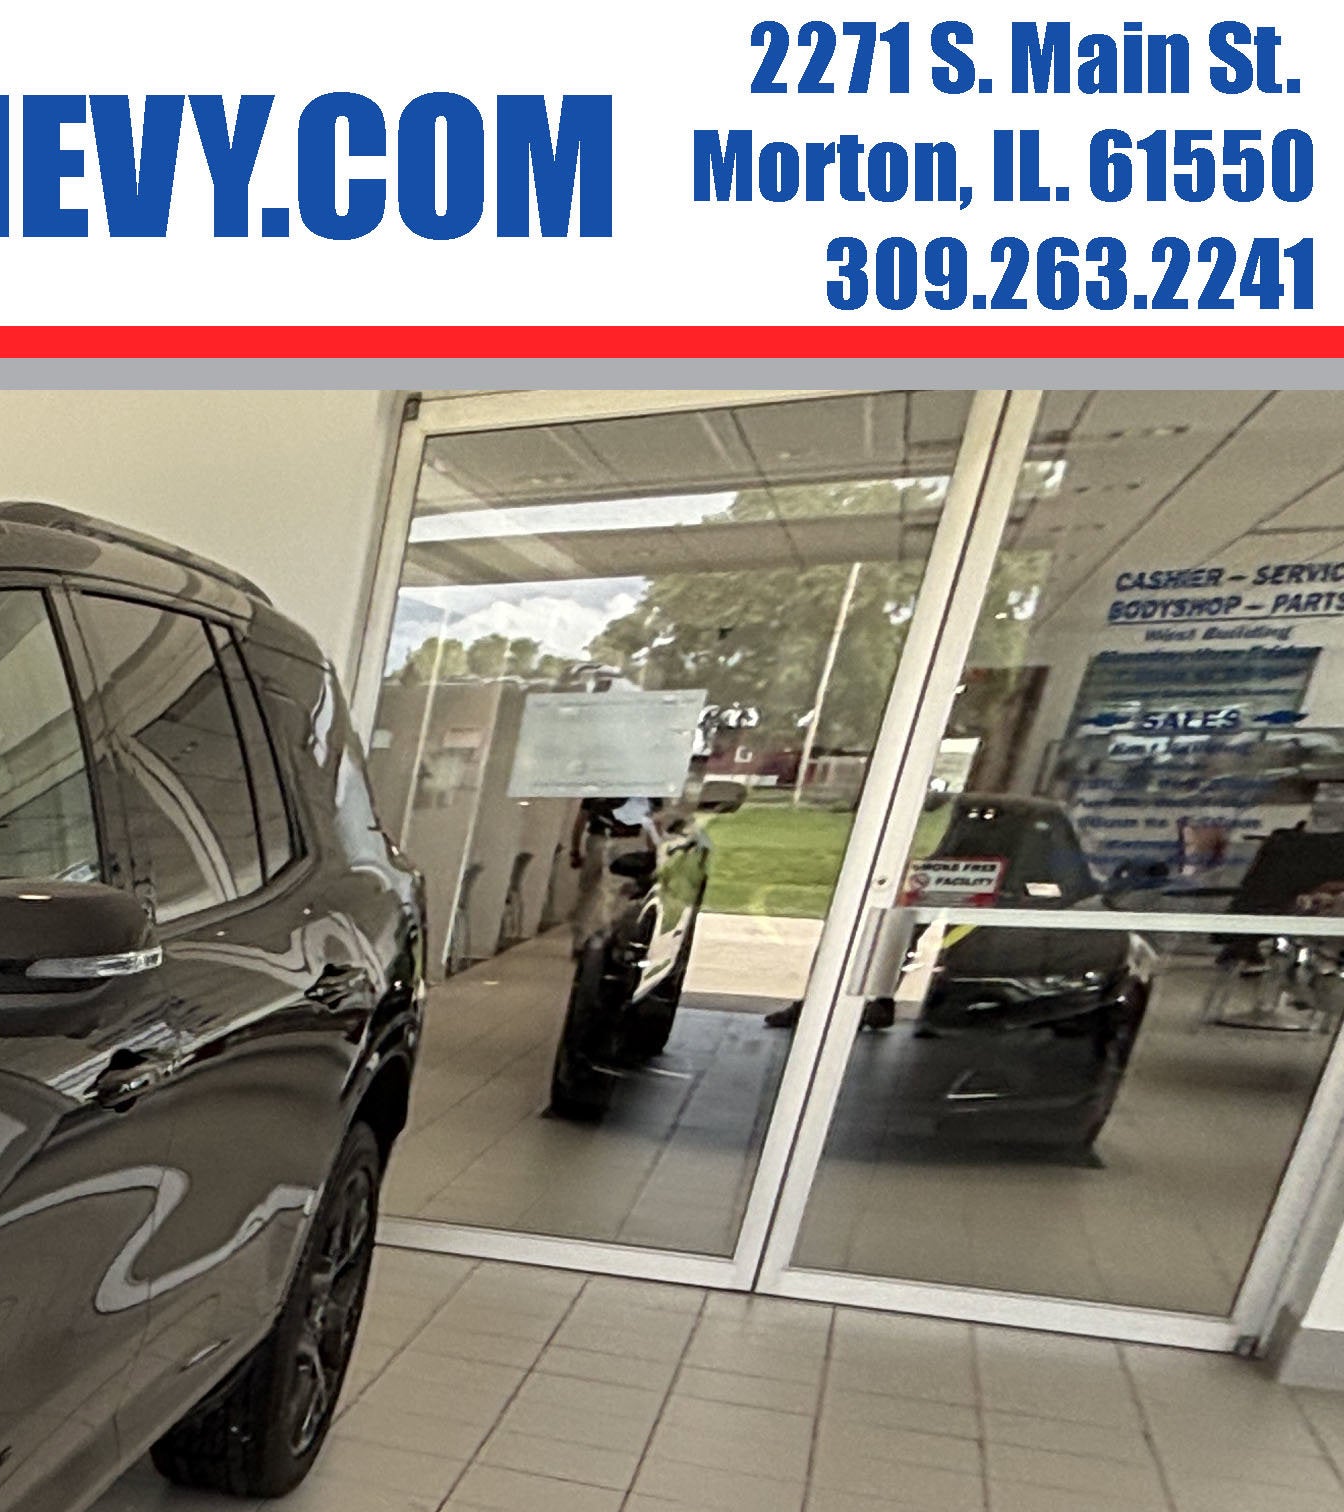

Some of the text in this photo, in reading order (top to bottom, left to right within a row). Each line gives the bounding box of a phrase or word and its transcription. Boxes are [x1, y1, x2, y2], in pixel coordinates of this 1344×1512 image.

[1115, 567, 1224, 592] CASHIER
[1108, 595, 1243, 621] BODYSHOP
[1270, 591, 1344, 614] PARTS
[1140, 708, 1241, 729] SALES
[962, 863, 998, 873] FREE
[934, 877, 994, 886] FACILITY
